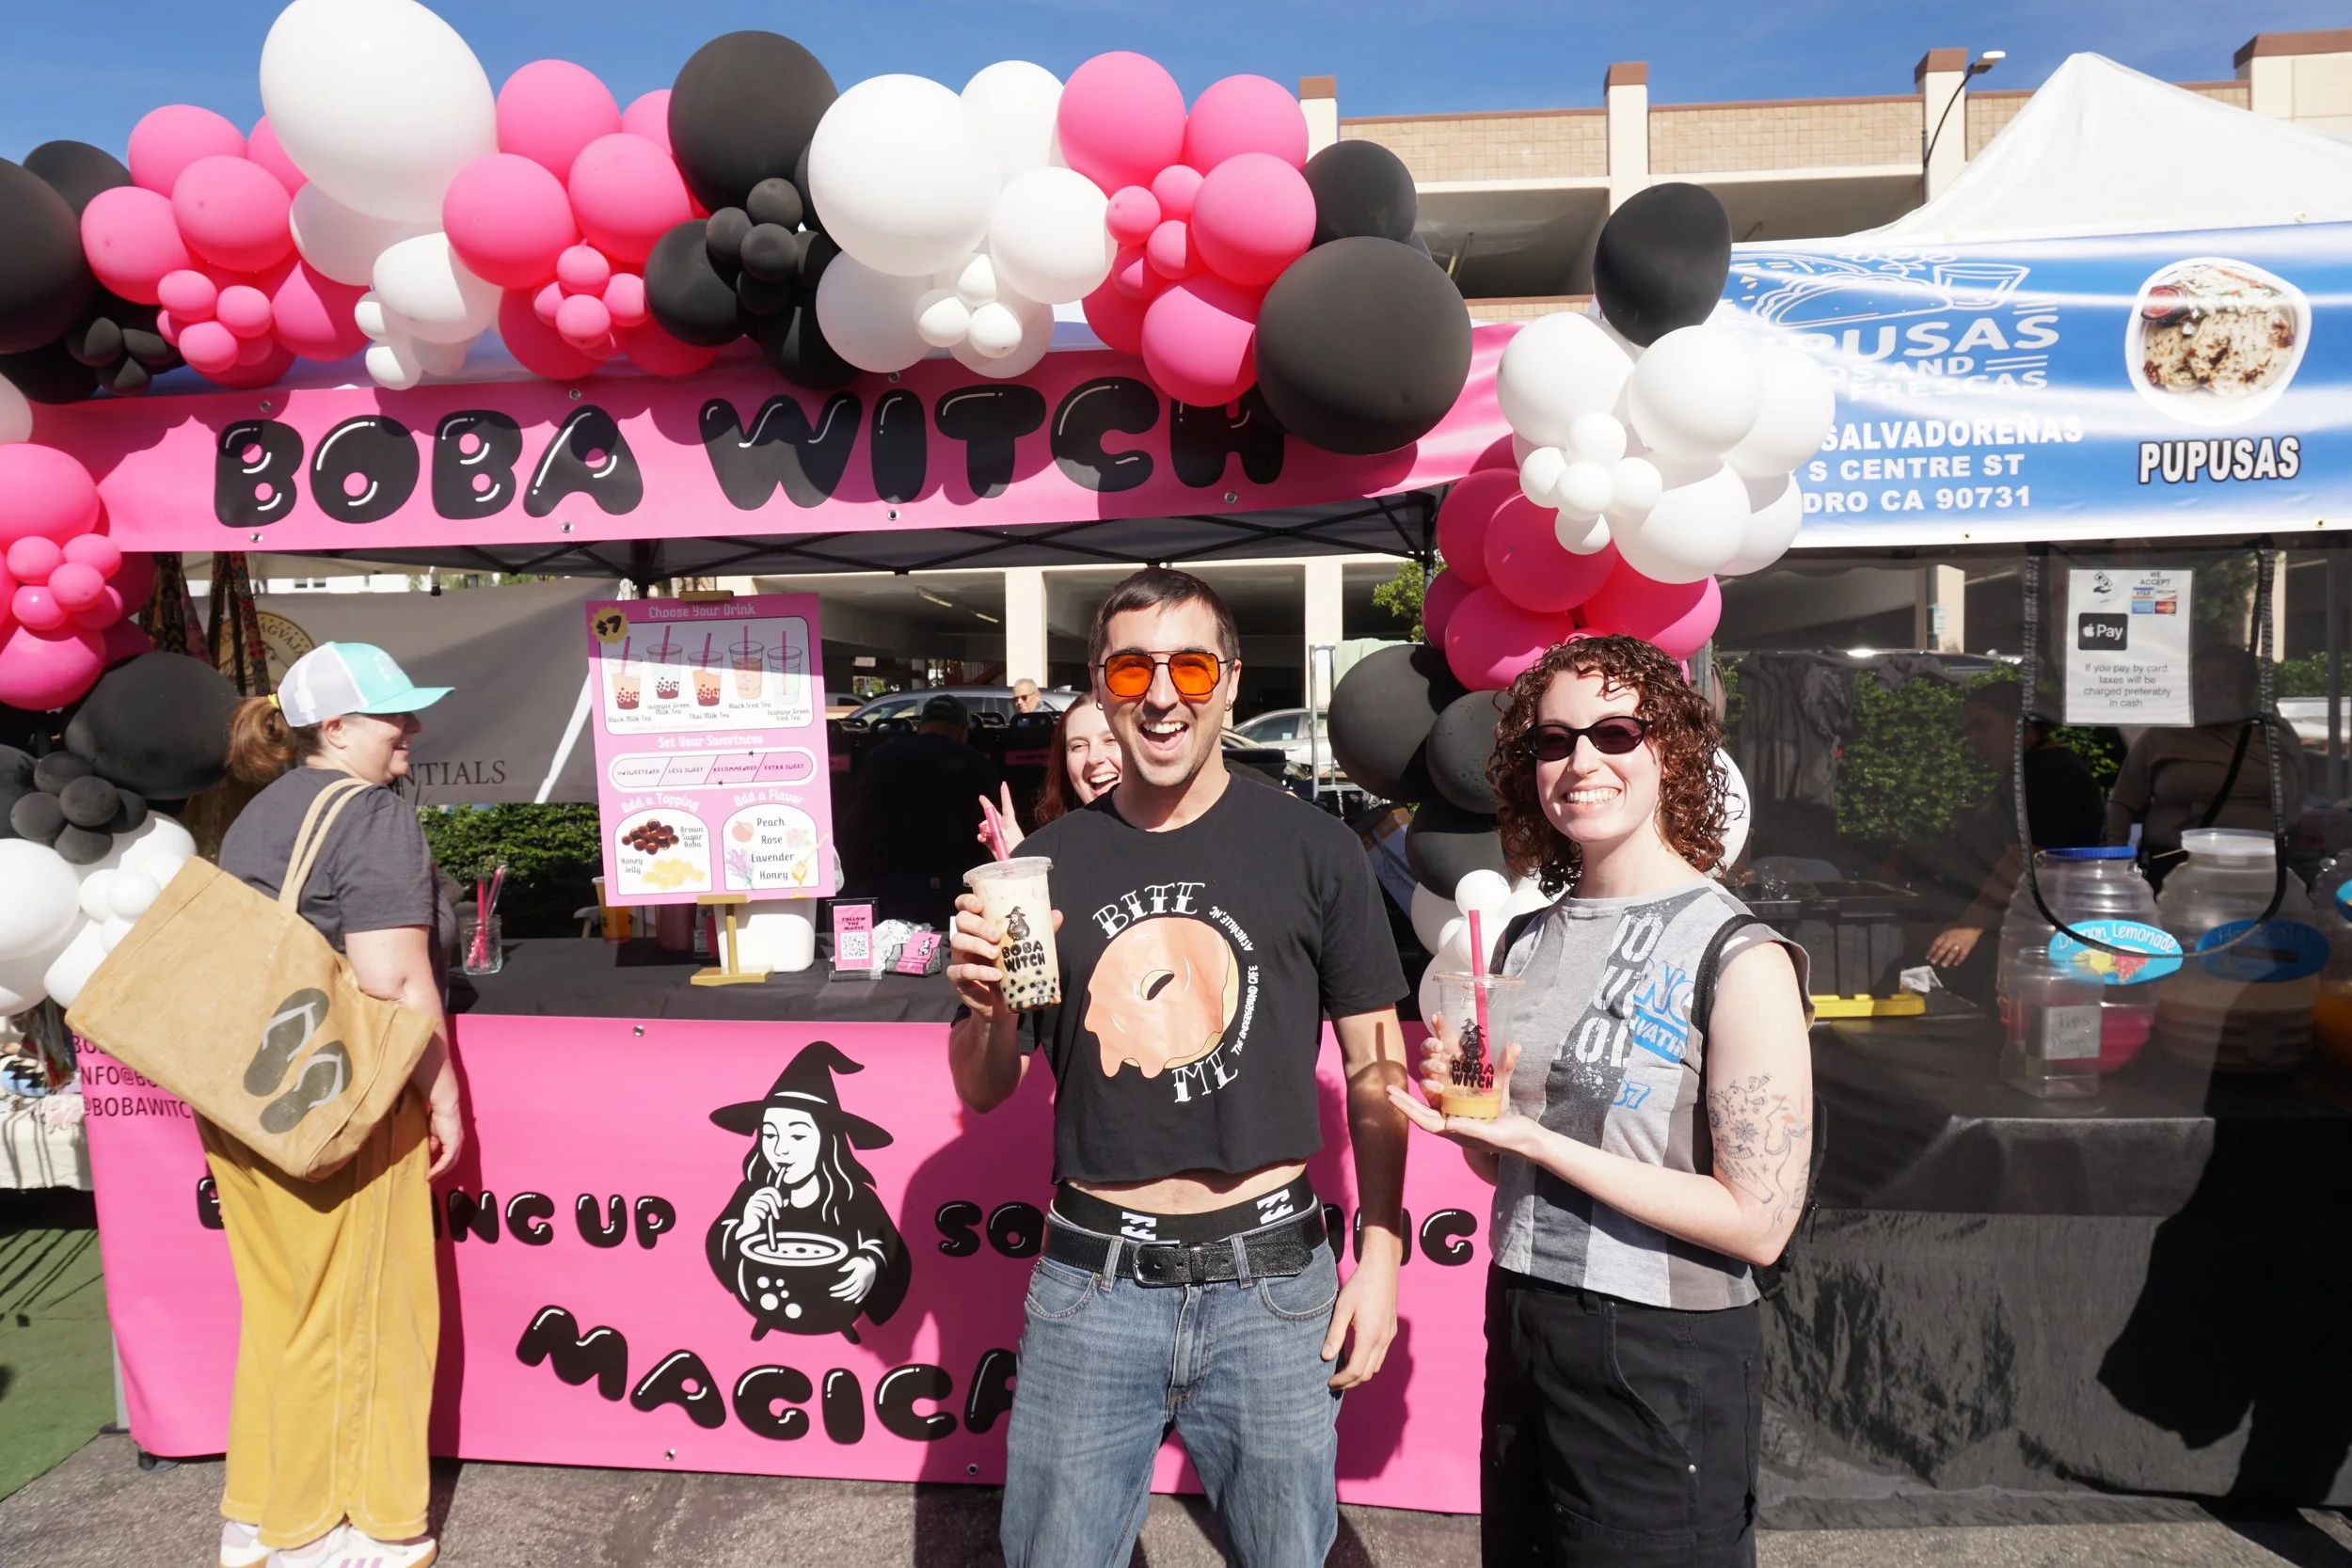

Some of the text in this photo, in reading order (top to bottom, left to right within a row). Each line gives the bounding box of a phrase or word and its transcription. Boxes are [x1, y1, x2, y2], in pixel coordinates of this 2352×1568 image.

[1788, 314, 2060, 361] PUSAS
[1888, 356, 1975, 378] AND
[1850, 371, 2049, 402] FRESCAS
[214, 376, 1285, 528] BOBA WITCH
[2138, 436, 2301, 484] PUPUSAS
[1808, 453, 2025, 482] S CENTRE ST
[1803, 484, 2030, 514] DRO CA 90731
[649, 602, 755, 618] Choose Your Drink
[596, 615, 622, 636] $7
[2096, 625, 2123, 641] Pay
[2086, 663, 2090, 672] If
[2094, 664, 2111, 673] you
[2114, 665, 2130, 673] pay
[2133, 664, 2144, 673] by
[2084, 688, 2171, 697] charged preferably
[2109, 699, 2118, 707] in
[659, 735, 763, 749] Set Your Sweetness
[402, 760, 506, 786] NTIALS
[713, 765, 757, 773] RECOMMENDED
[621, 792, 699, 814] Add a Topping
[733, 793, 755, 808] Add
[769, 788, 804, 805] Flavor
[756, 817, 785, 827] Peach
[682, 833, 703, 844] Sugar
[761, 835, 783, 845] Rose
[621, 857, 644, 866] Honey
[751, 852, 795, 863] Lavender
[759, 871, 788, 881] Honey
[2112, 923, 2176, 953] Lemonade
[1002, 941, 1043, 958] BOBA
[1004, 953, 1045, 973] WITCH
[1231, 1037, 1244, 1056] THE
[1239, 986, 1259, 1039] UNDERGROUND
[1452, 1059, 1494, 1075] BOBA
[1452, 1071, 1494, 1088] WITCH
[576, 1193, 676, 1249] UP
